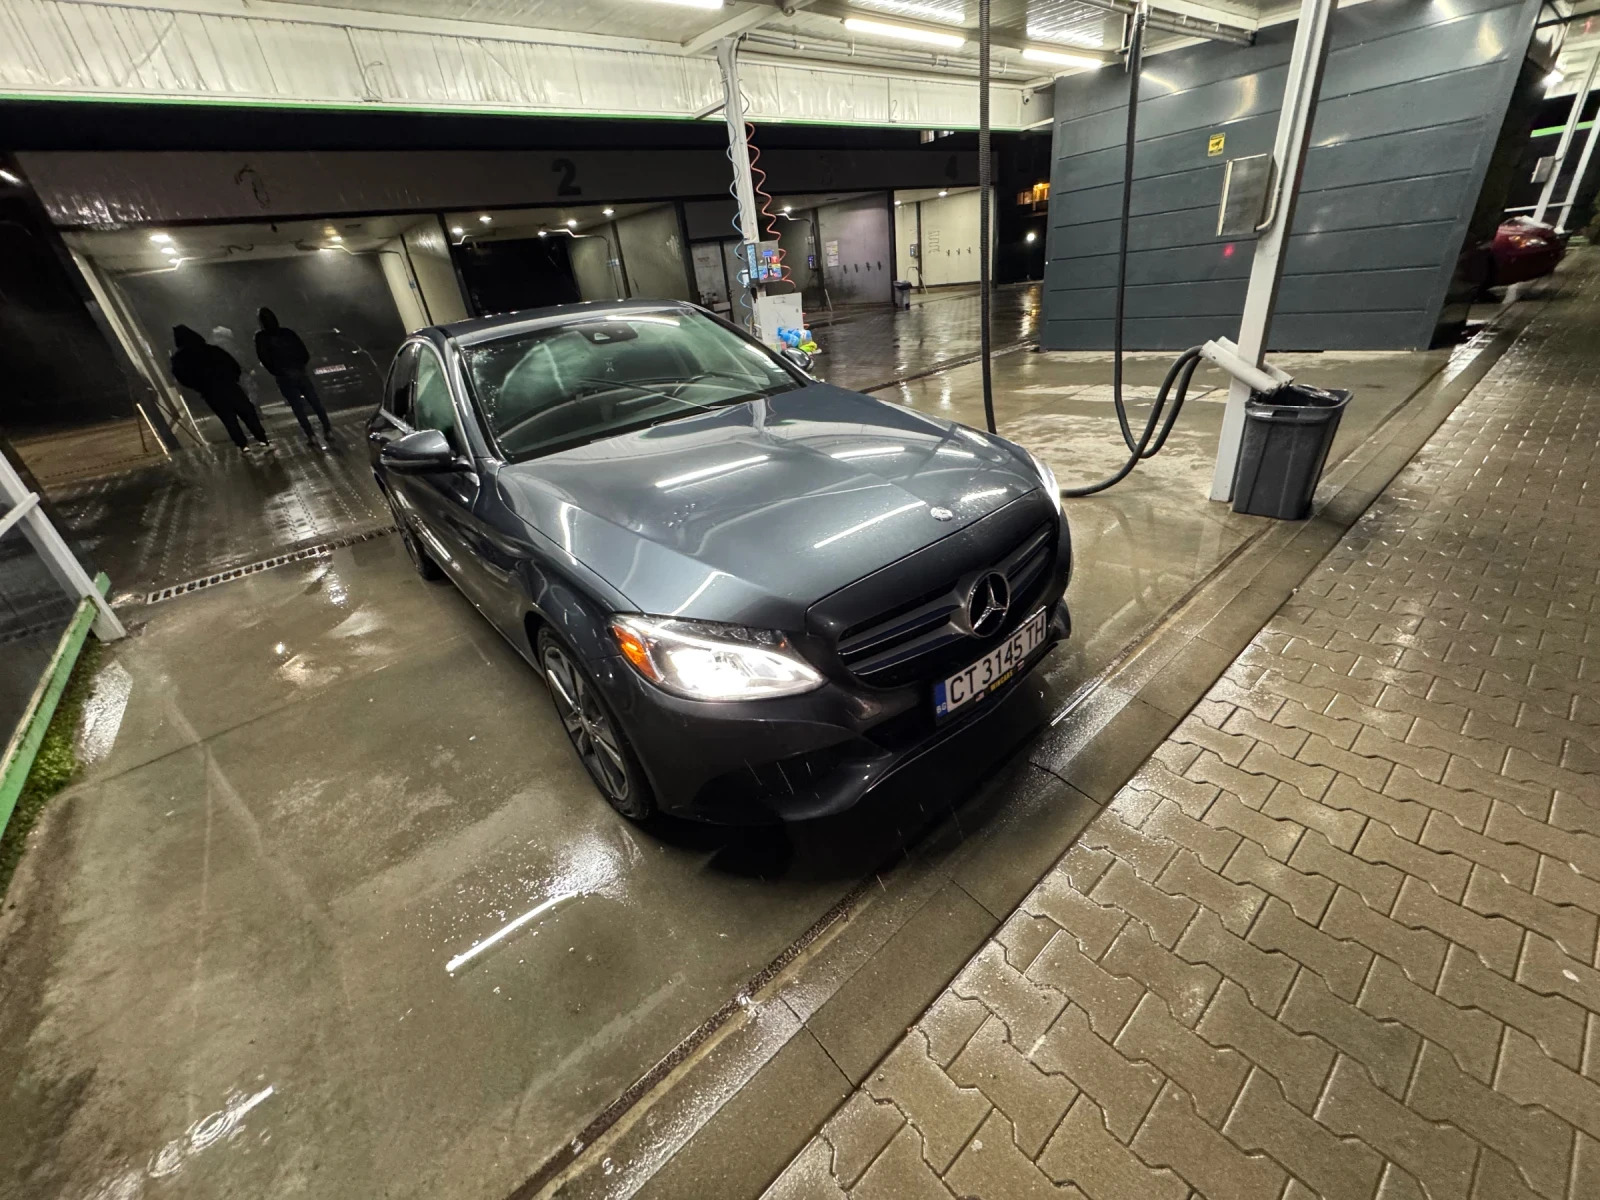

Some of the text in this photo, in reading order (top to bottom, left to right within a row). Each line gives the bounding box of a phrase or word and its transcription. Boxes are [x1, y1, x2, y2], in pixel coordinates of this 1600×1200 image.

[552, 158, 581, 196] 2
[951, 615, 1044, 704] CT 3145 TH
[936, 703, 947, 714] BG
